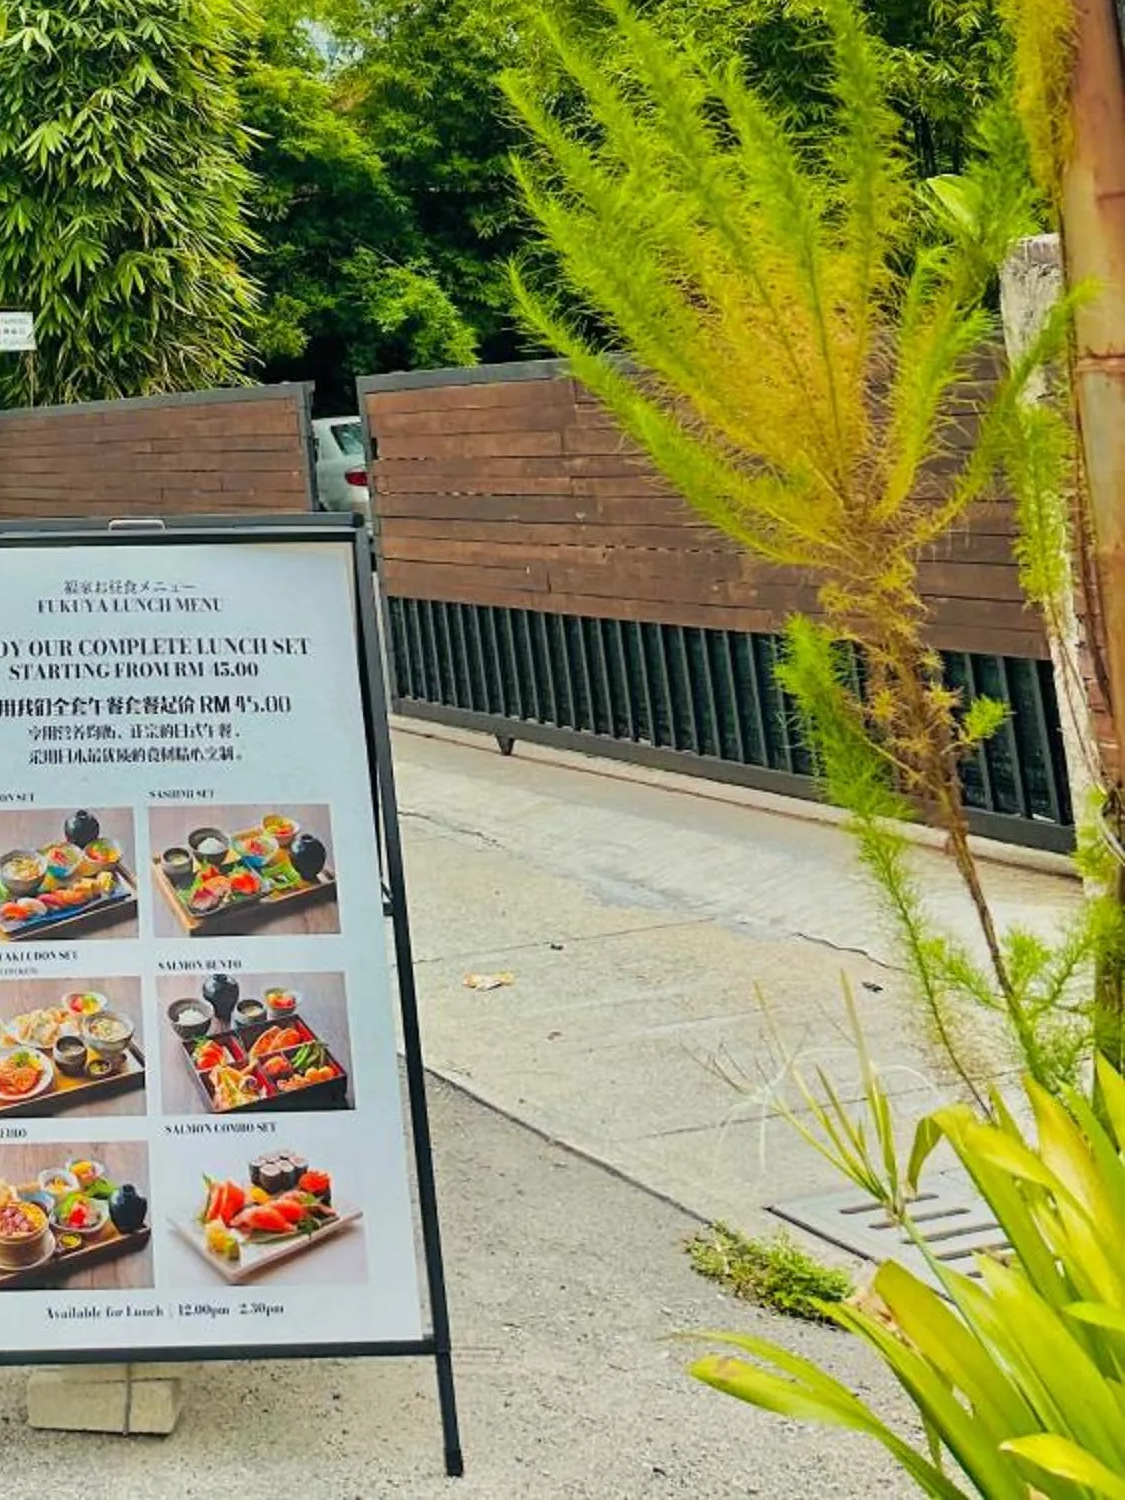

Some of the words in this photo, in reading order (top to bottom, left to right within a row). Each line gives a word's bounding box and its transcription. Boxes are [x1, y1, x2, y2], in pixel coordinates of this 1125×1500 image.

[37, 598, 109, 614] FUKUYA
[114, 598, 171, 613] LUNCH
[176, 597, 224, 613] MENU
[29, 639, 74, 657] OUR
[78, 637, 192, 656] COMPLETE
[197, 637, 268, 655] LUNCH
[272, 636, 312, 655] SET
[8, 663, 111, 681] STARTING
[114, 661, 170, 679] FROM
[174, 661, 204, 678] RM
[211, 661, 259, 678] 45.00
[199, 695, 231, 714] RM
[234, 694, 292, 713] 45.00
[148, 788, 194, 799] SASHIMI
[196, 788, 215, 799] SET
[58, 950, 78, 961] SET
[158, 960, 202, 971] SALMON
[204, 959, 242, 970] BENTO
[165, 1123, 212, 1135] SALMON
[213, 1122, 255, 1133] COMBO
[257, 1121, 277, 1132] SET
[45, 1306, 102, 1320] Available
[106, 1304, 123, 1318] for
[126, 1304, 164, 1318] Lunch
[178, 1303, 230, 1319] 12.00pm
